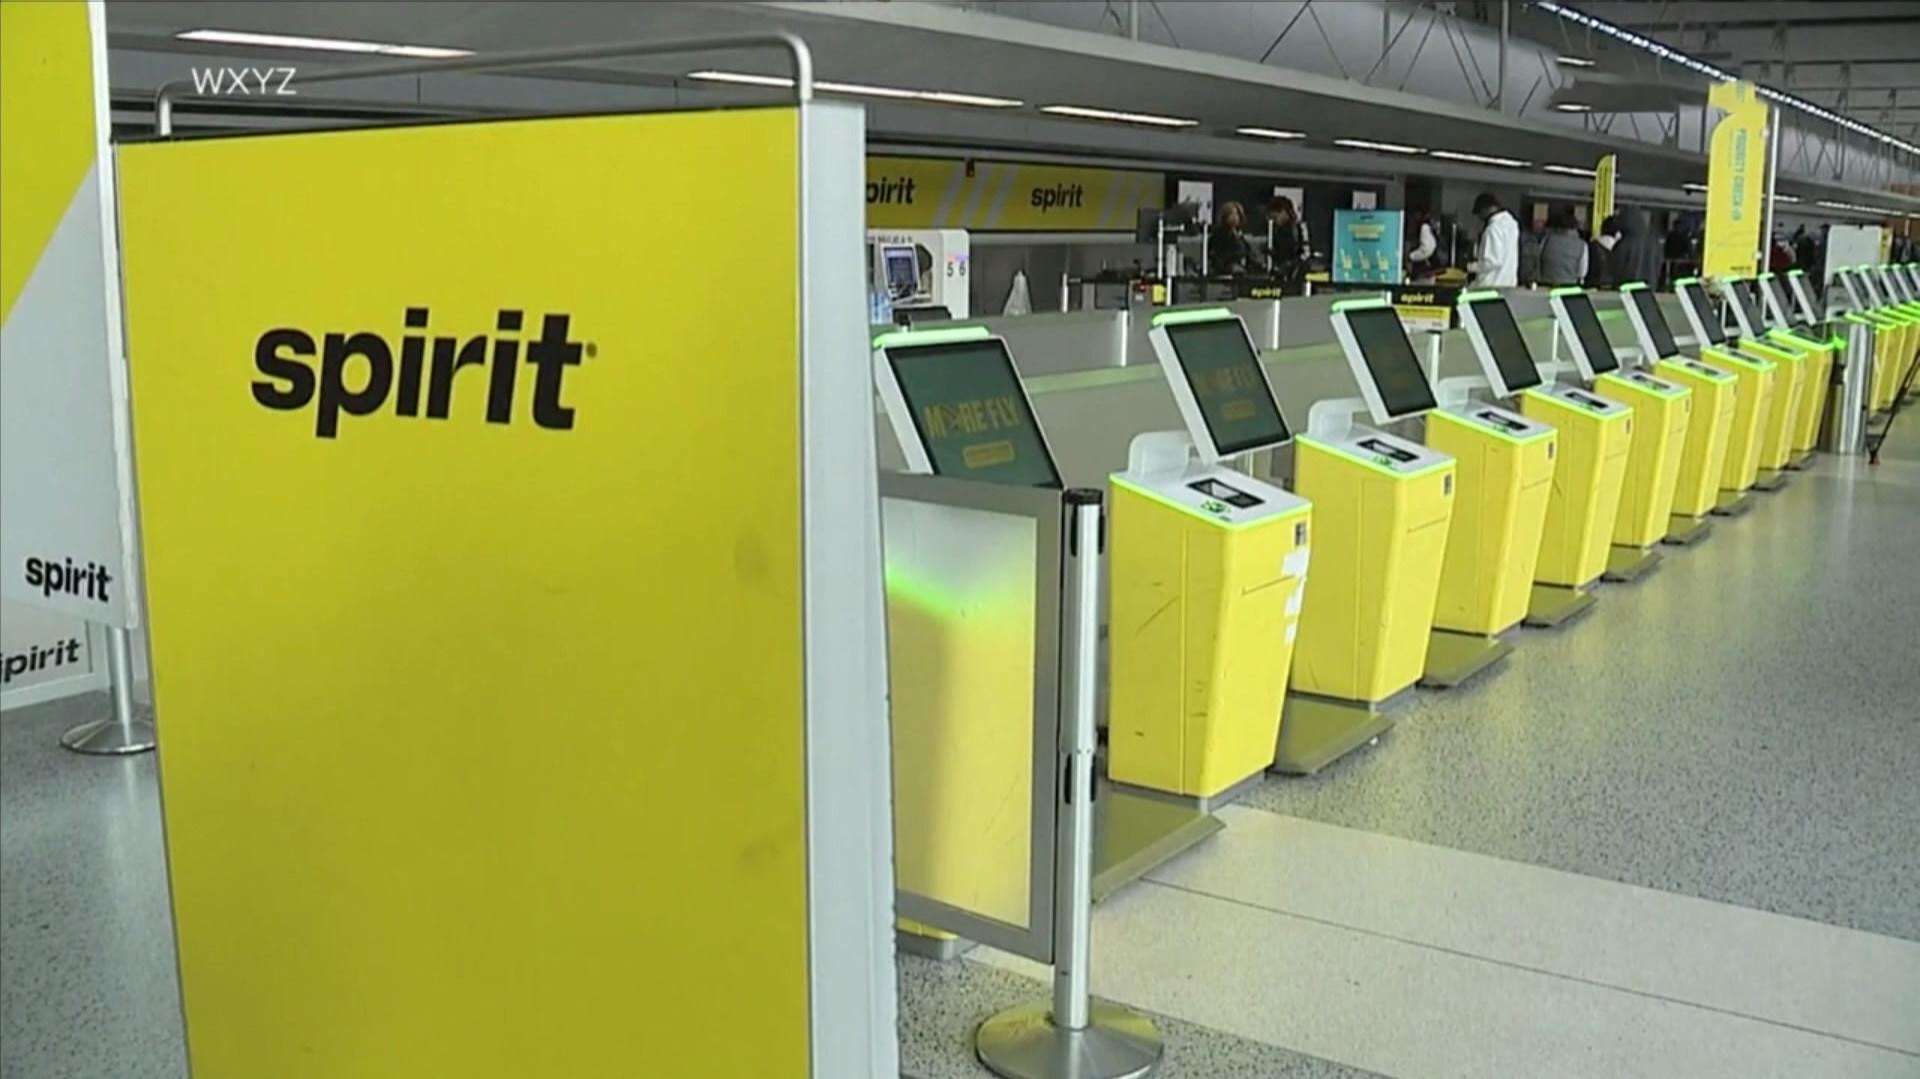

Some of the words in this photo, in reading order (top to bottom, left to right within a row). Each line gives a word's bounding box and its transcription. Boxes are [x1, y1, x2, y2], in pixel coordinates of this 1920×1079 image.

[866, 177, 916, 204] pirit
[1031, 183, 1083, 212] spirit
[251, 307, 584, 440] spirit
[25, 557, 112, 603] spirit
[0, 638, 81, 683] pirit
